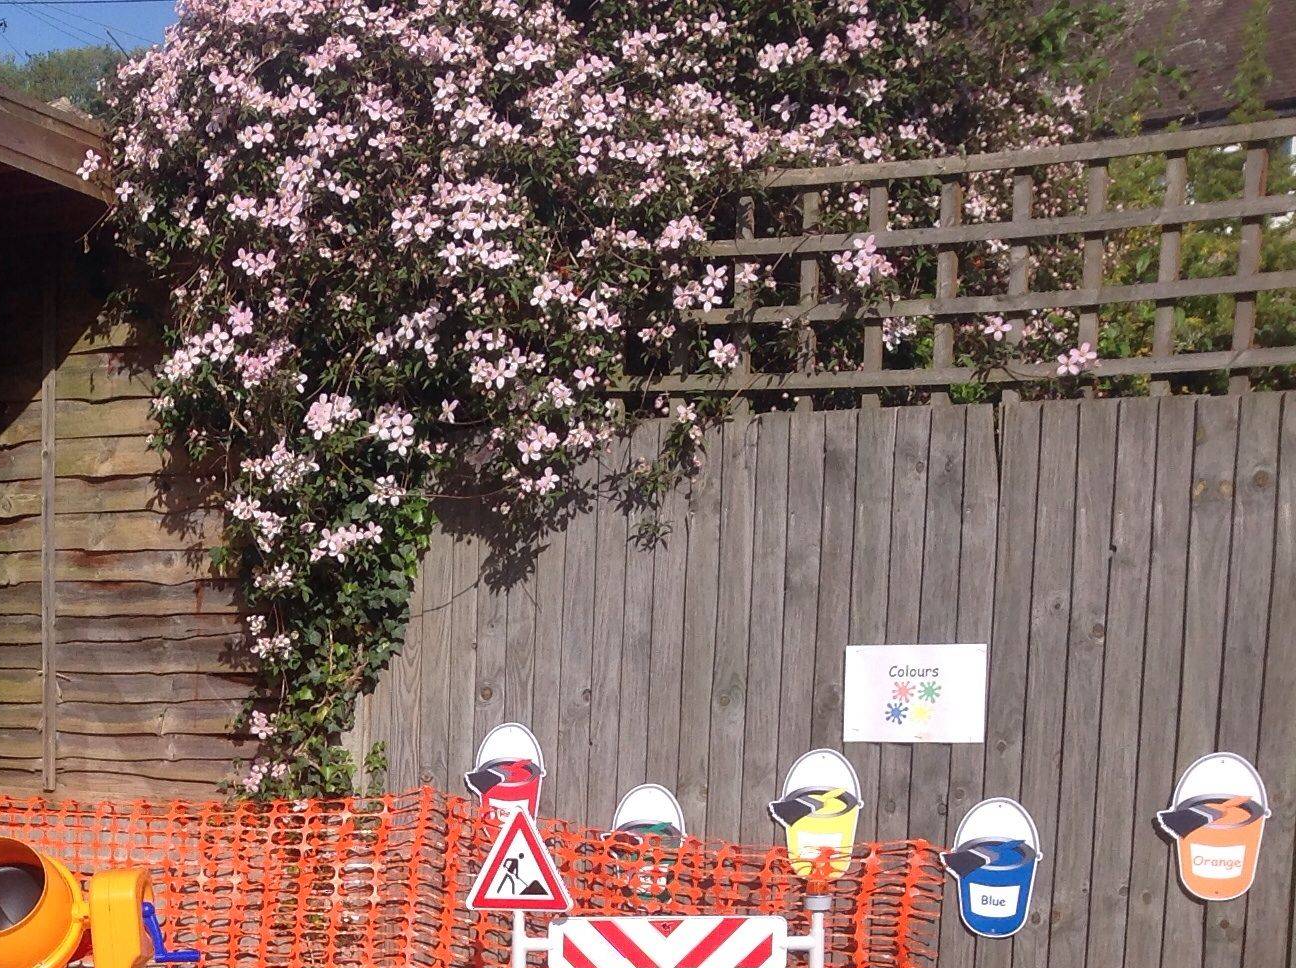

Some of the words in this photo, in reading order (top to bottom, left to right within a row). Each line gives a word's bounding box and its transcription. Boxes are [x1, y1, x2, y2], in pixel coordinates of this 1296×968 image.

[888, 665, 940, 678] Colours
[1193, 855, 1241, 870] Orange
[981, 894, 1006, 907] Blue
